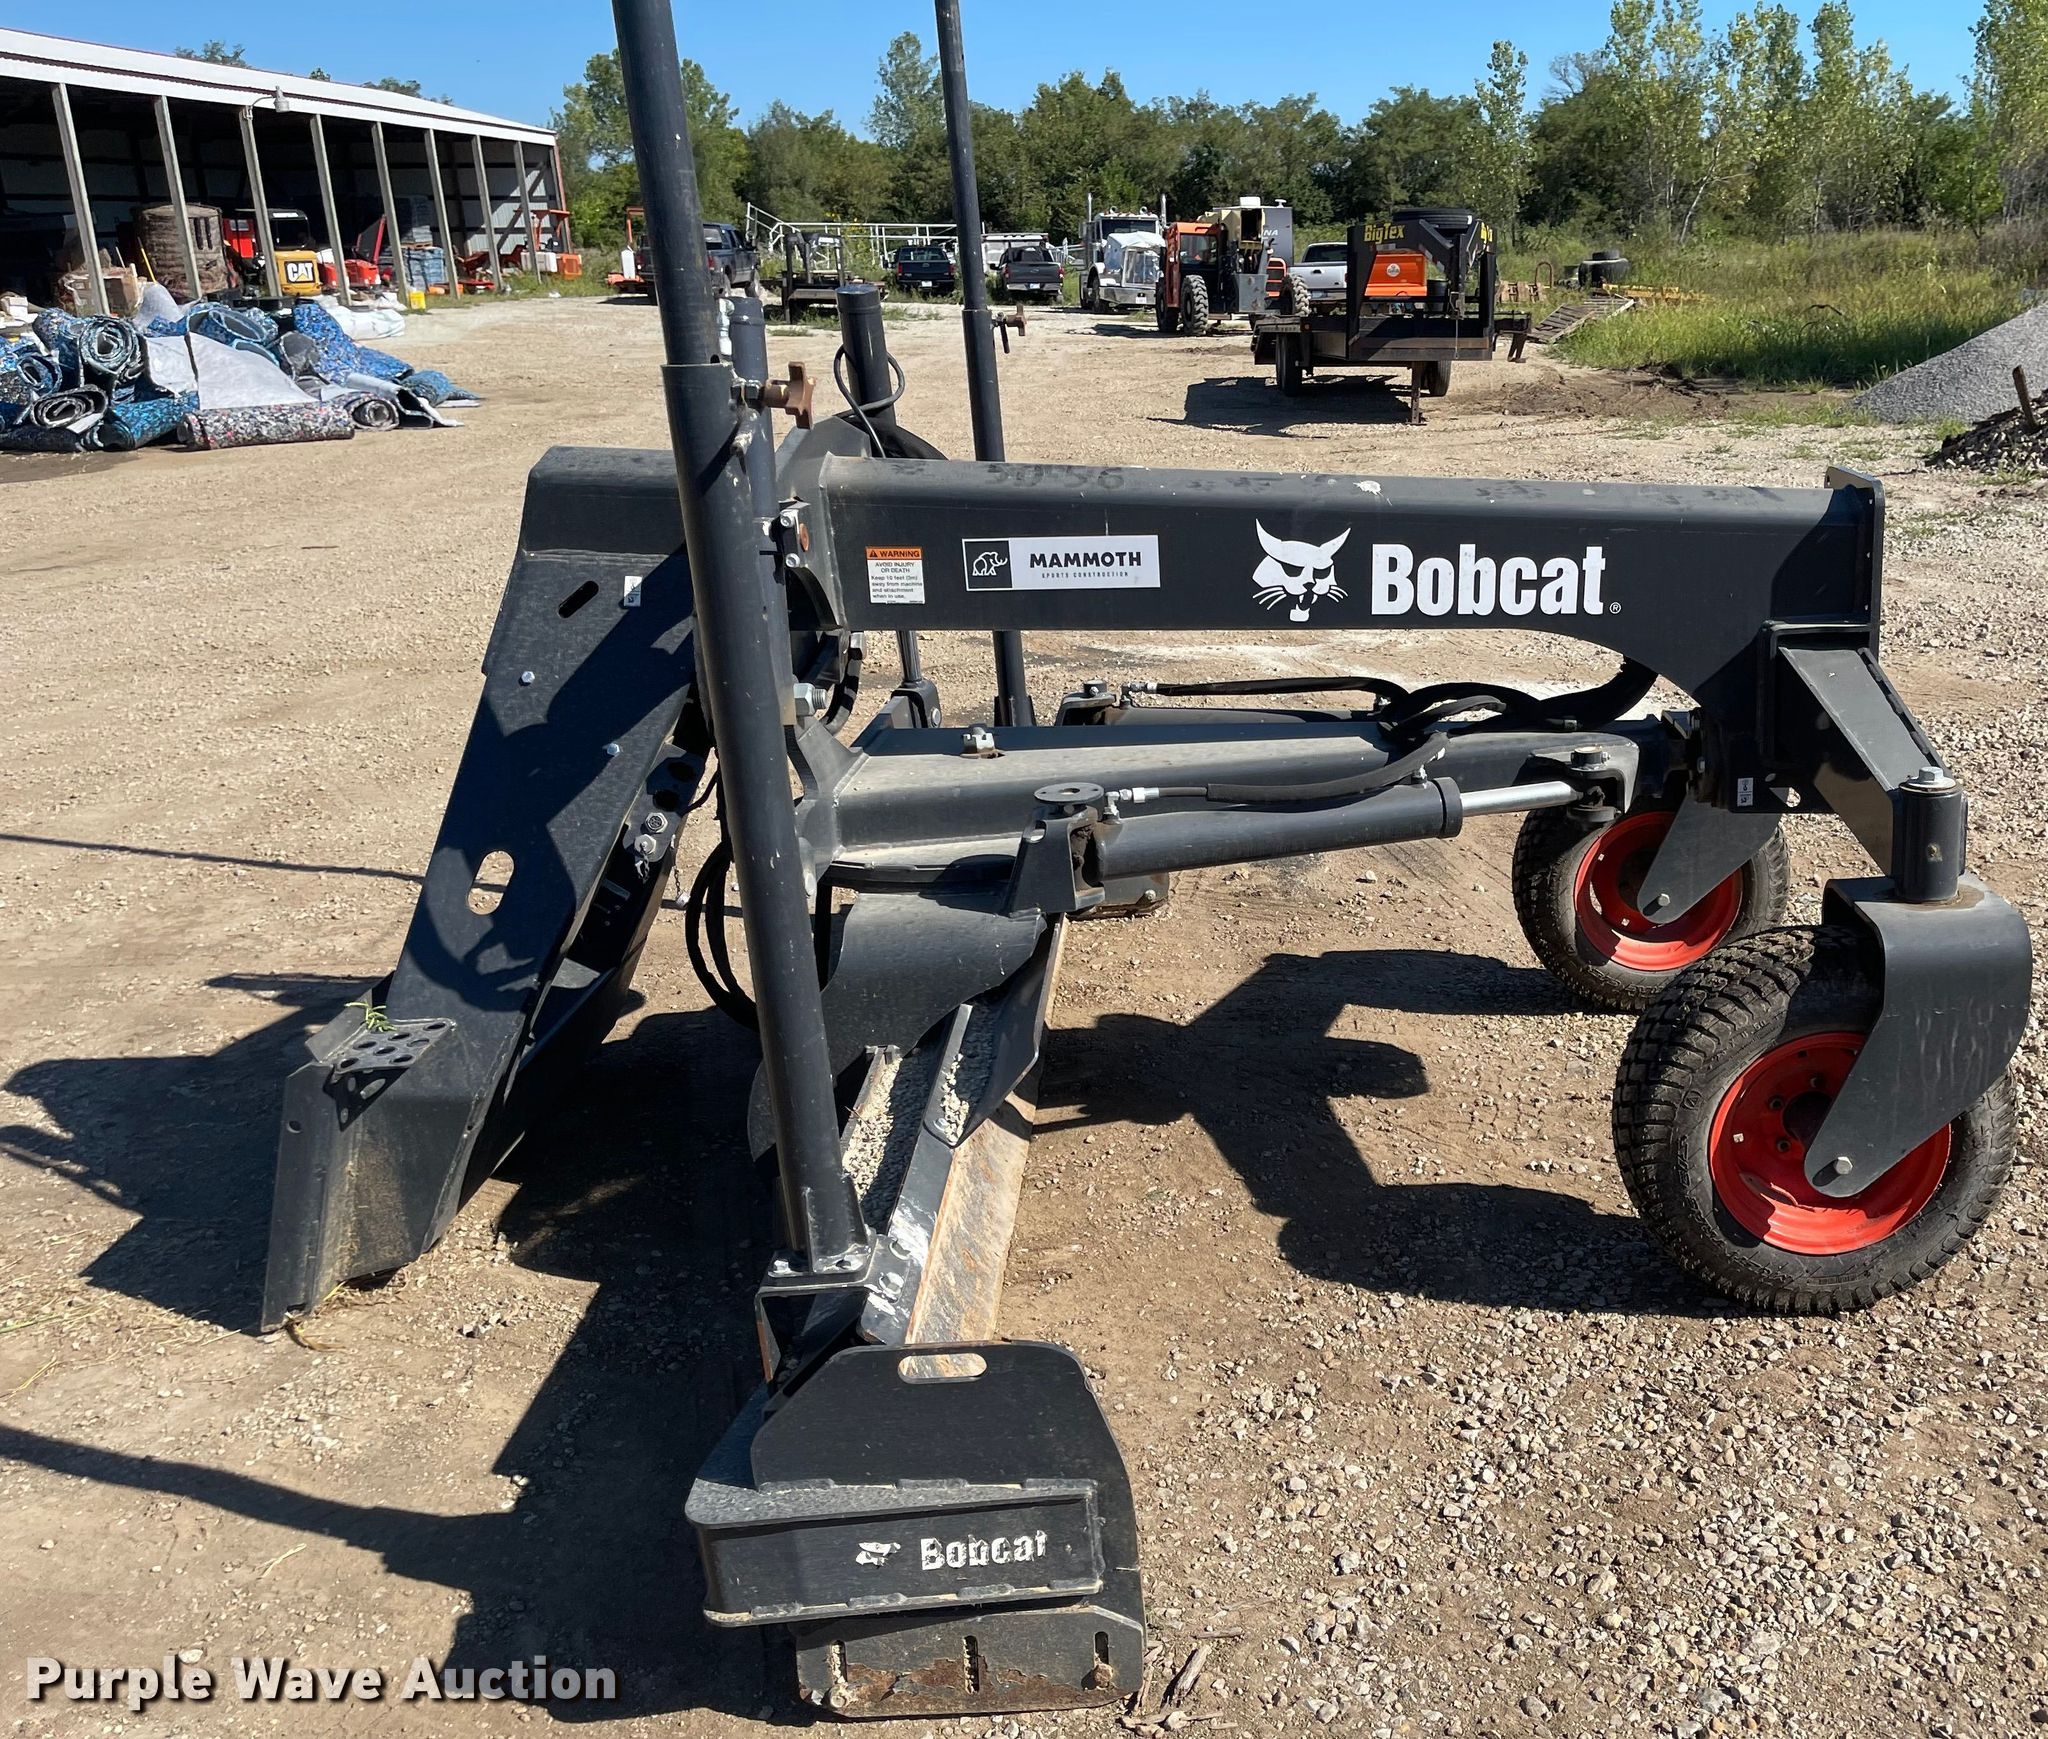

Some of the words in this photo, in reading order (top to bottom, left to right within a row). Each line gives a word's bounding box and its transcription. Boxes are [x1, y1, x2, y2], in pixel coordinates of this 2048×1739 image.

[286, 262, 314, 282] CAT
[879, 550, 920, 558] WARNING
[1029, 551, 1142, 568] MAMMOTH
[1371, 543, 1606, 616] Bobcat
